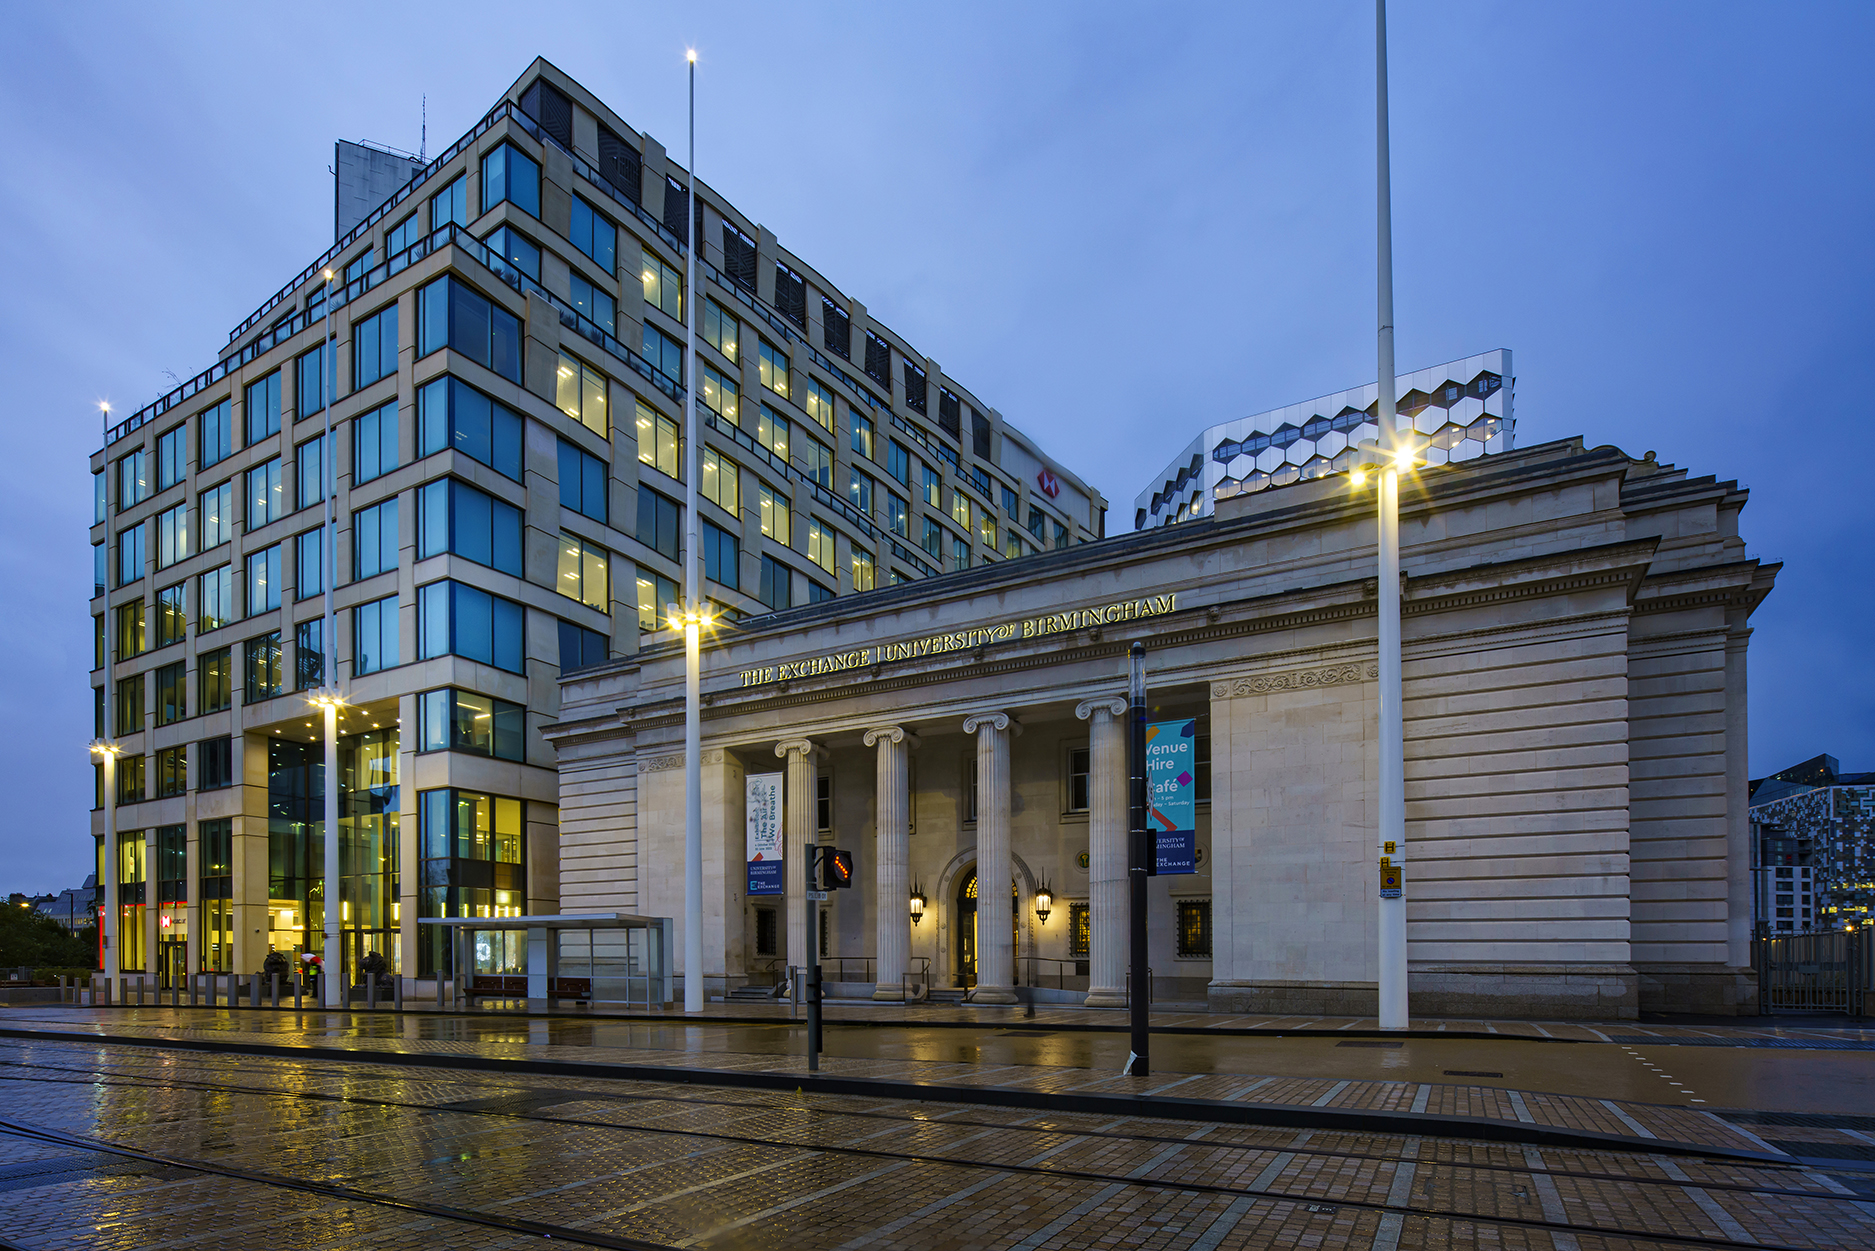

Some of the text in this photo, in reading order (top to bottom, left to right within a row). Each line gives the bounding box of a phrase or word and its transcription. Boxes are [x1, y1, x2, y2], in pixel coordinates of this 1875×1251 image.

[739, 666, 773, 687] THE
[777, 649, 871, 681] EXCHANGE
[883, 627, 998, 662] UNIVERSITY
[1020, 593, 1176, 639] BIRMINGHAM
[1146, 743, 1188, 756] Venue
[1146, 758, 1174, 772] Hire
[1153, 778, 1178, 793] afé
[769, 823, 775, 838] We
[1386, 842, 1394, 852] H
